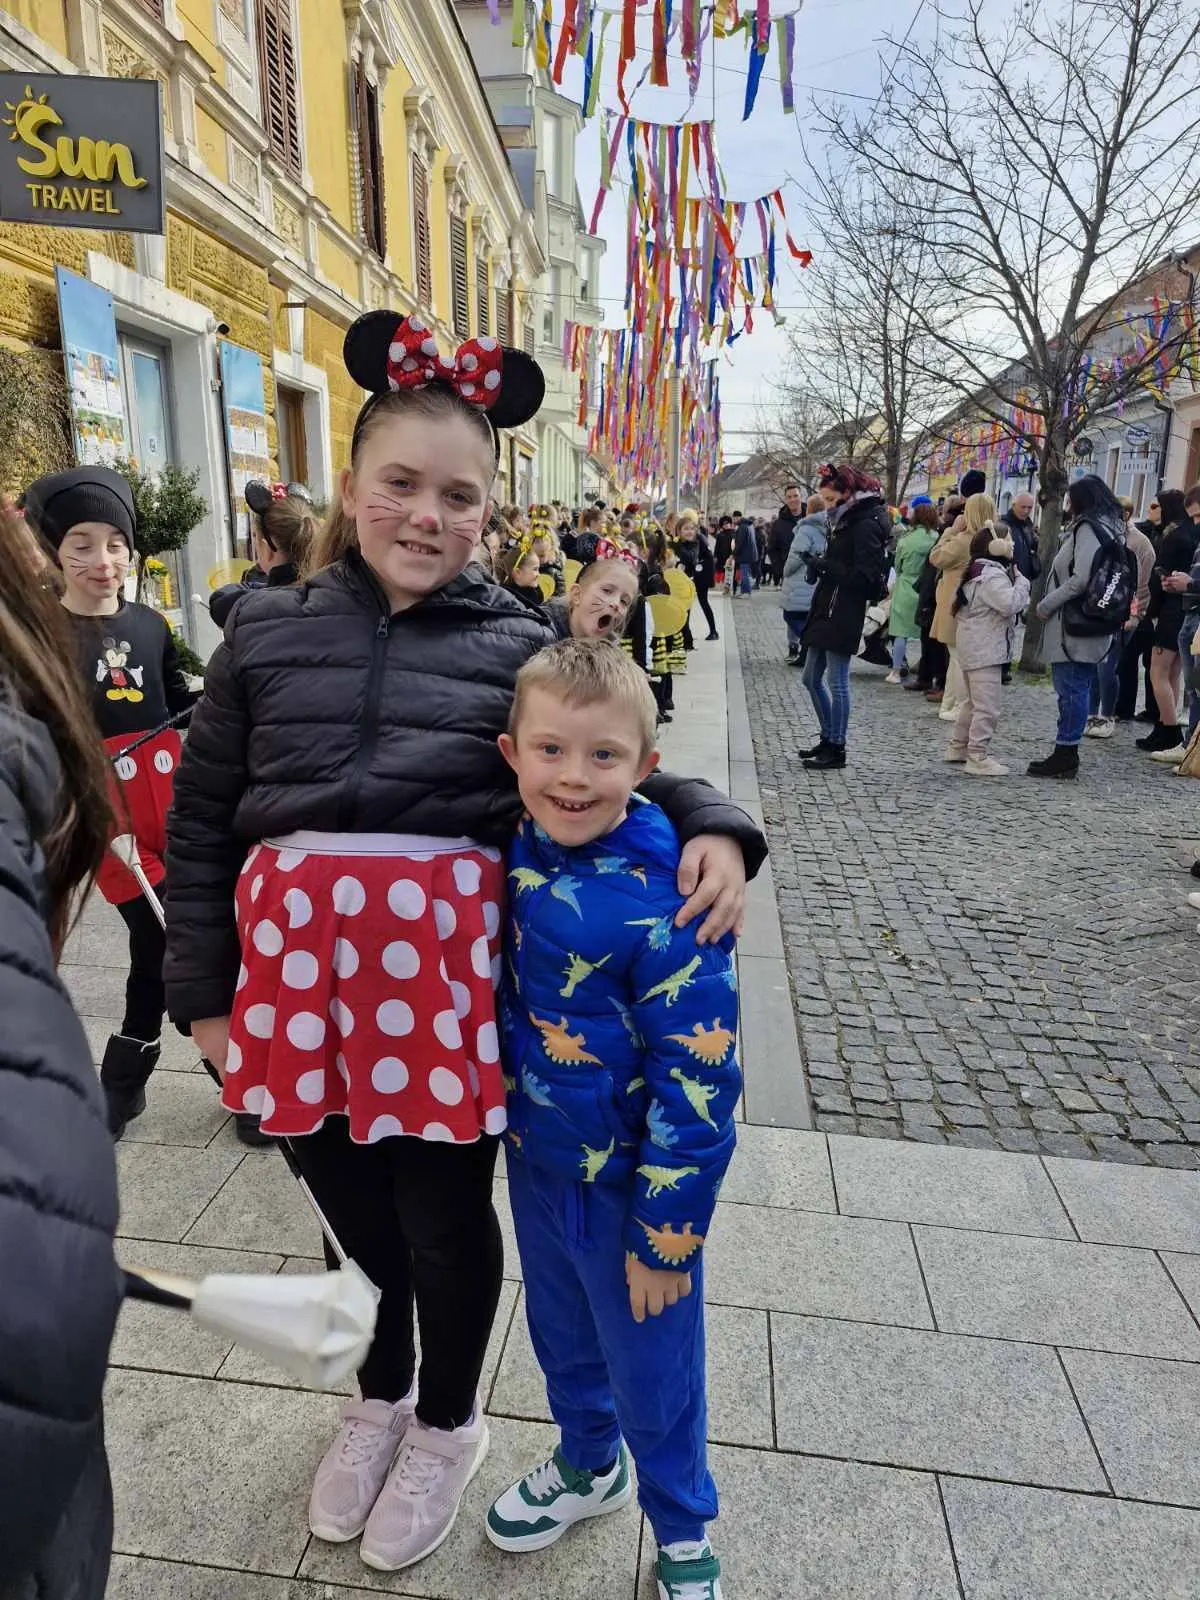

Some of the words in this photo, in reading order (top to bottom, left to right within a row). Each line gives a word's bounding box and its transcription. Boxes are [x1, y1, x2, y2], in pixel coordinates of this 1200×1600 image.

[15, 101, 148, 189] Sun
[25, 183, 121, 215] TRAVEL
[1097, 571, 1122, 609] Reebok
